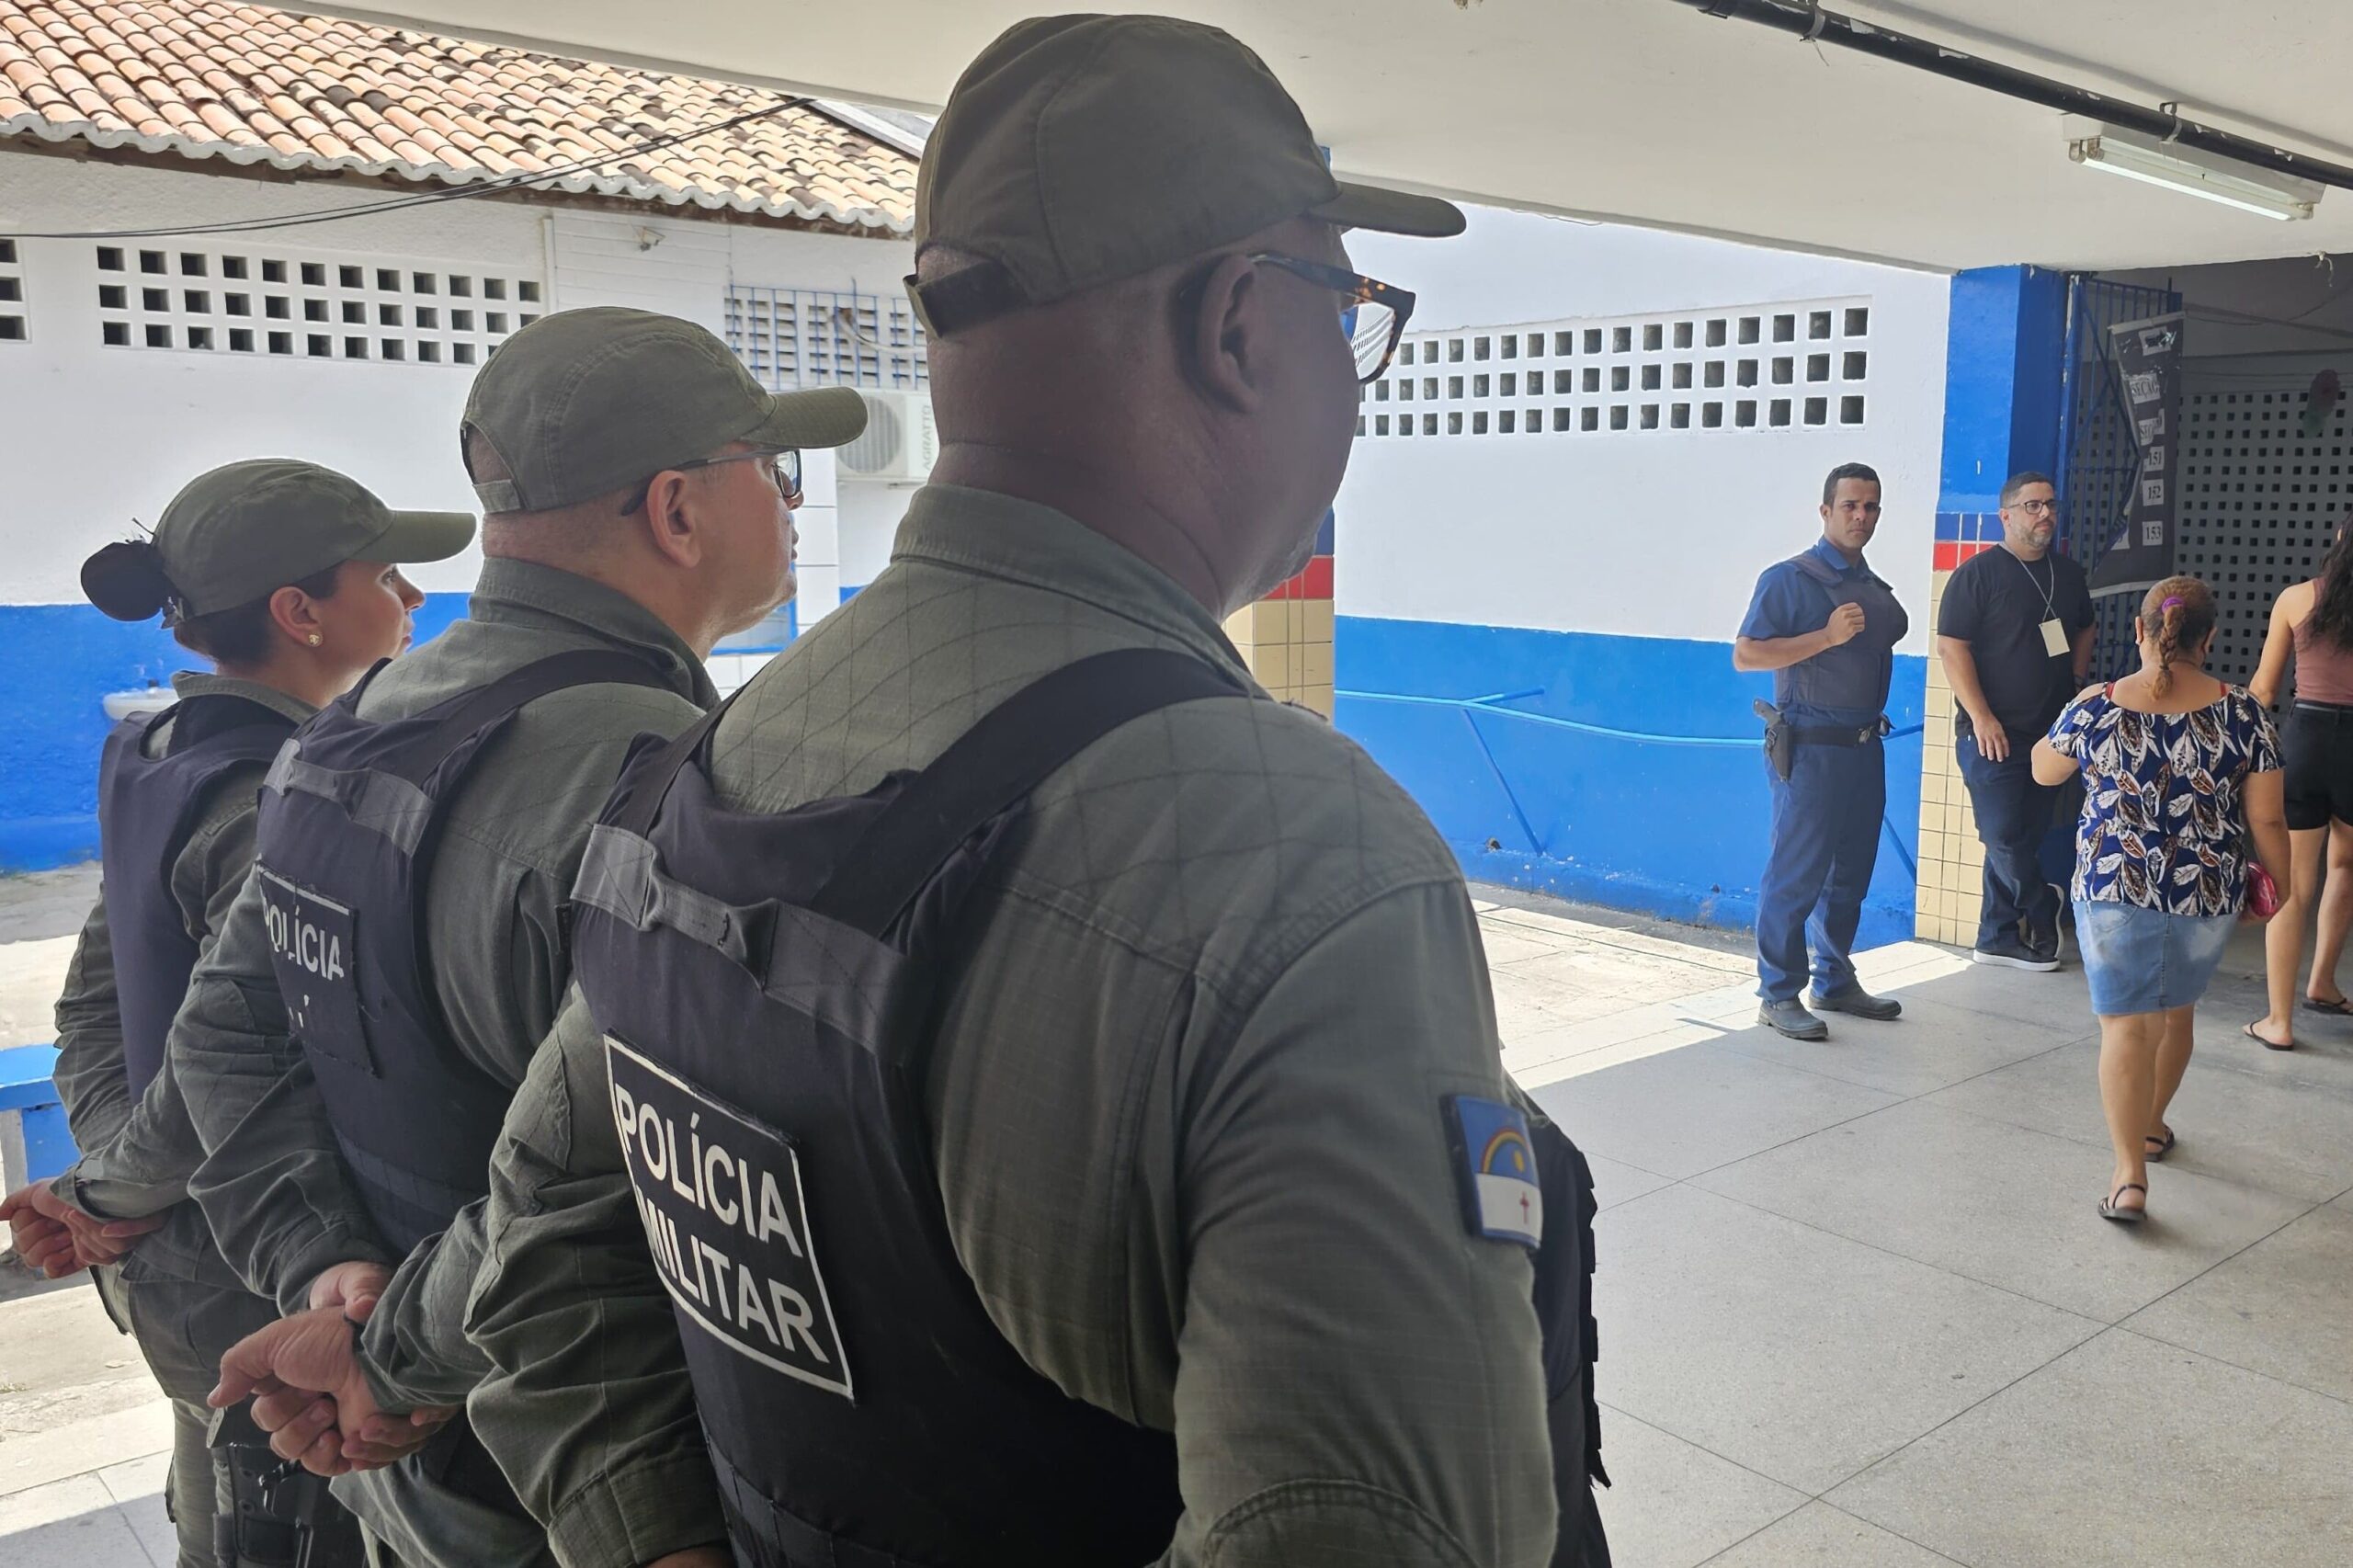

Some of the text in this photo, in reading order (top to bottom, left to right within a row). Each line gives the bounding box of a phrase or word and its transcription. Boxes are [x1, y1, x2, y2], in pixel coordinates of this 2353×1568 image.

[922, 404, 932, 471] AGRATTO
[2148, 451, 2162, 466] 151
[2148, 485, 2161, 499] 152
[2146, 526, 2161, 540] 153
[615, 1083, 802, 1257] POLÍCIA
[636, 1185, 830, 1364] MILITAR
